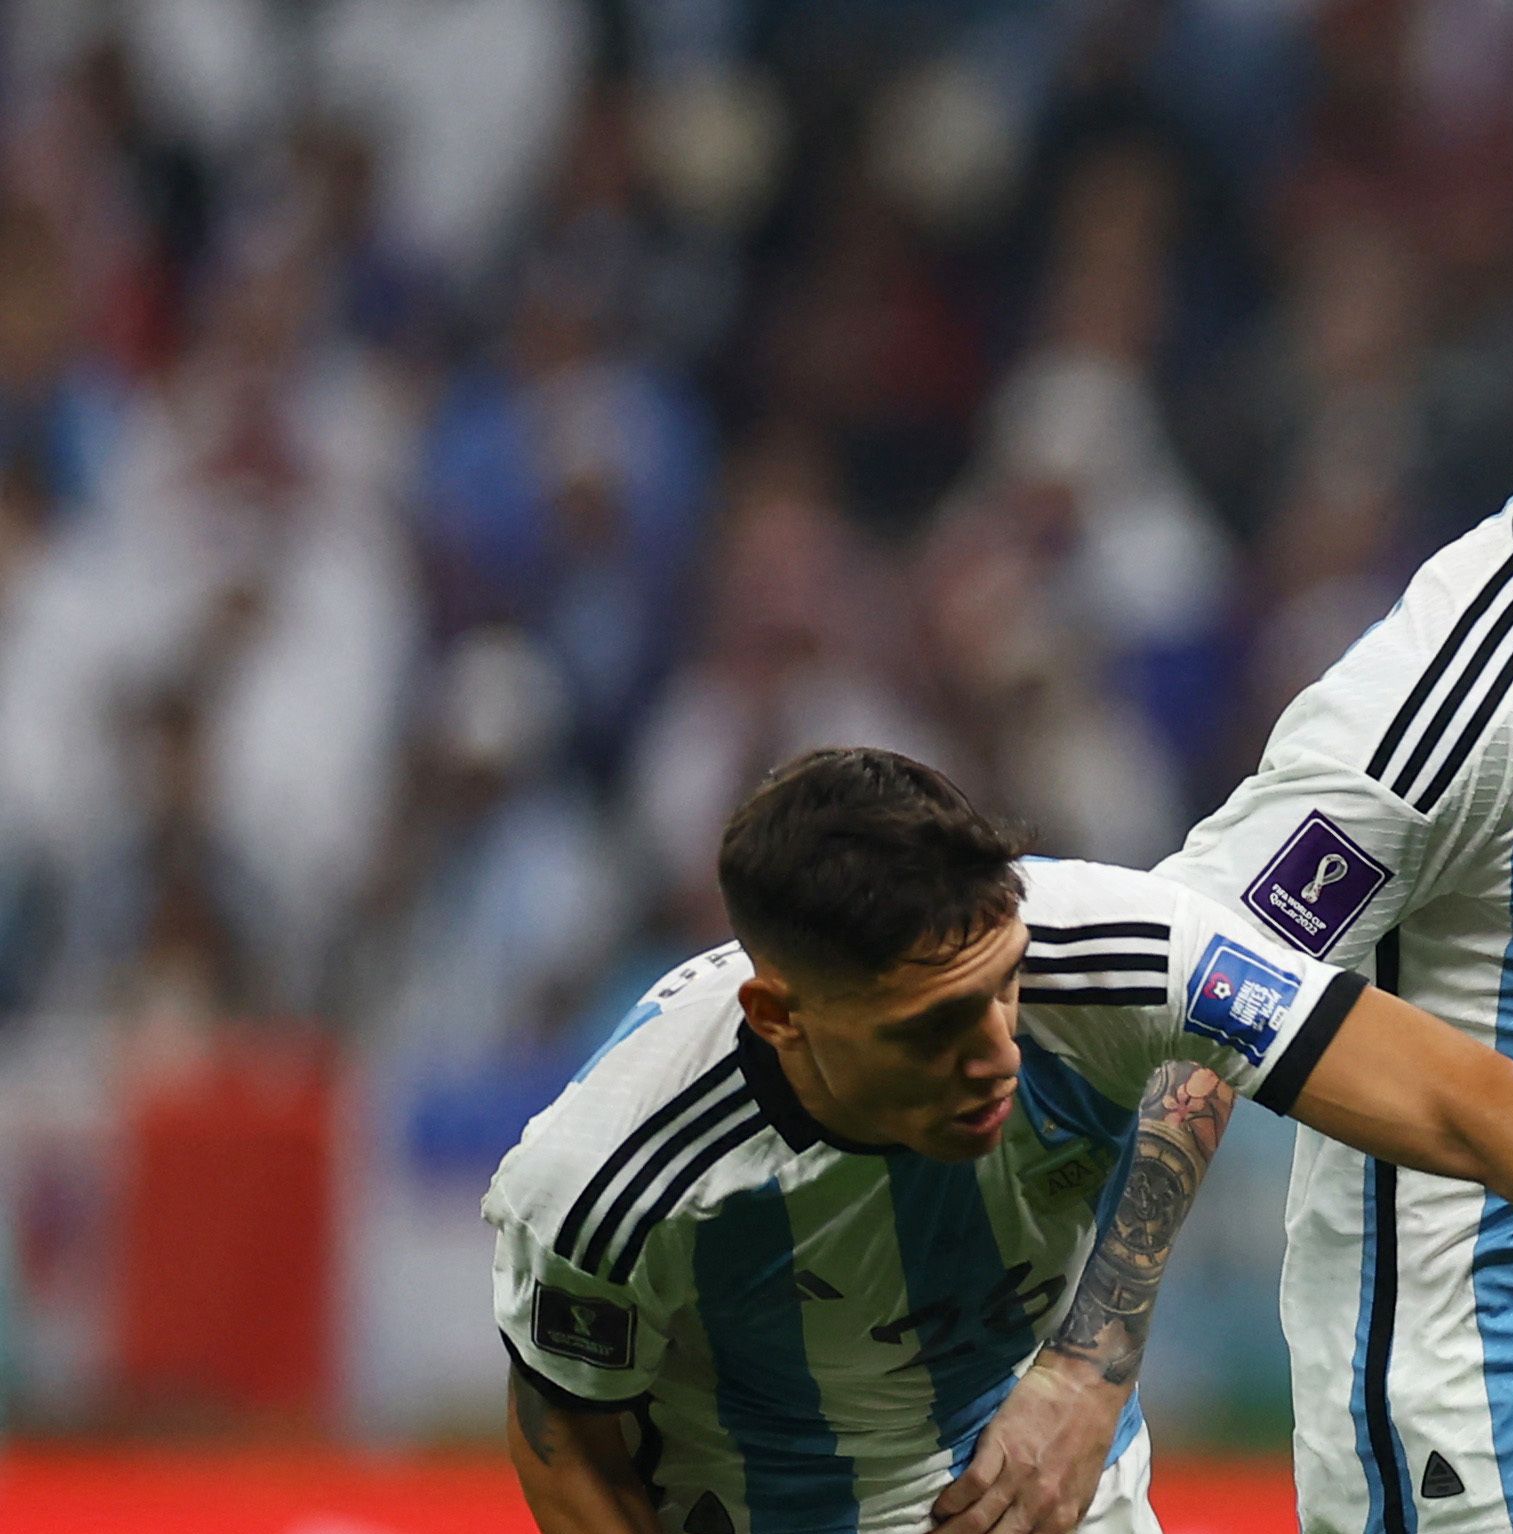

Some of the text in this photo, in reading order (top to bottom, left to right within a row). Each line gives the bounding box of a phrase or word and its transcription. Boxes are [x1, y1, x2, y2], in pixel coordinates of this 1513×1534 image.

[1272, 883, 1327, 930] FIFA WORLD CUP
[1236, 982, 1269, 1027] UNITES
